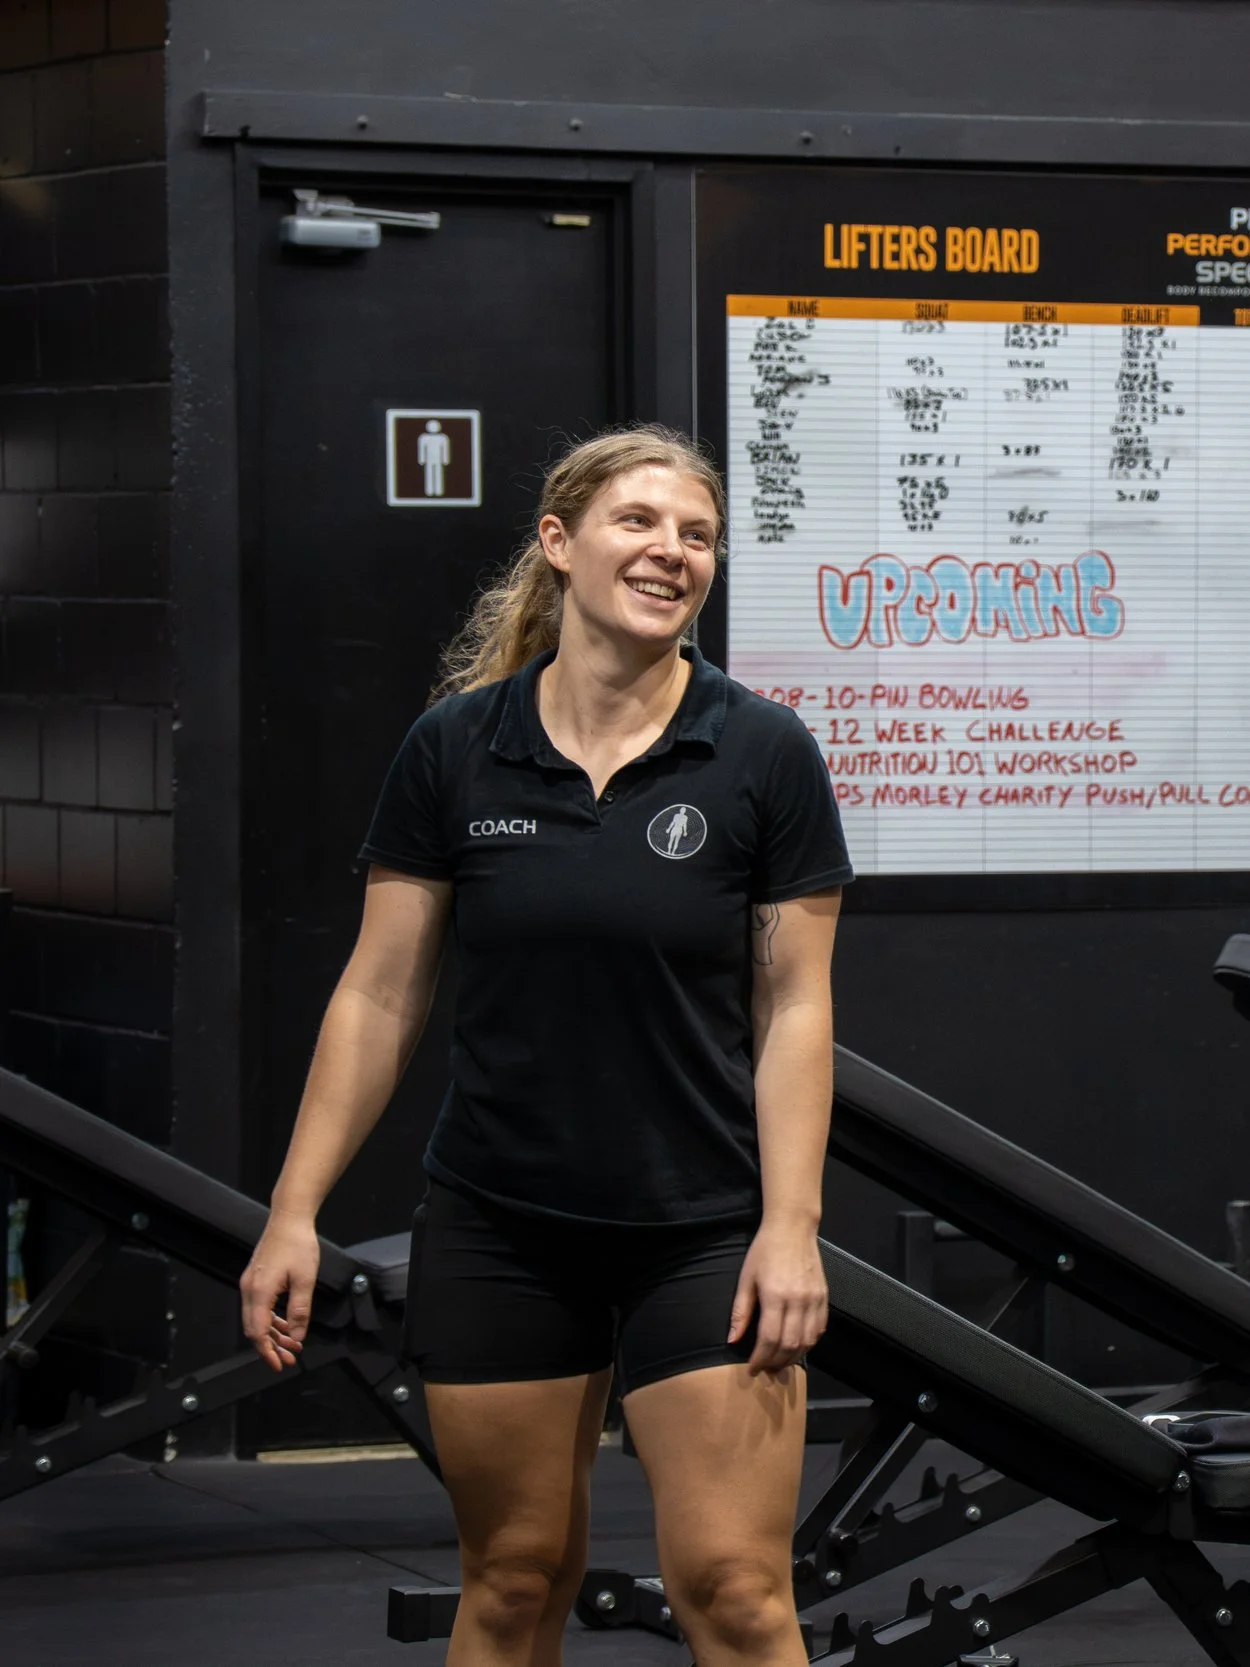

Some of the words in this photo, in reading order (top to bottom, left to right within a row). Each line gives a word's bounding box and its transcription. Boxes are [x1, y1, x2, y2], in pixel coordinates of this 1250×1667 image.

[823, 223, 938, 271] LIFTERS
[945, 226, 1041, 274] BOARD
[1166, 285, 1196, 296] BODY
[788, 301, 820, 316] NAME
[915, 303, 949, 320] SQUAT
[1023, 304, 1058, 321] BENCH
[1121, 307, 1170, 325] DEADLIFT
[918, 683, 1030, 710] BOWLING
[826, 718, 864, 745] 12
[874, 719, 947, 743] WEEK
[965, 718, 1125, 743] CHALLENGE
[996, 750, 1138, 776] WORKSHOP
[871, 782, 969, 809] MORLEY
[978, 783, 1075, 808] CHARITY
[468, 819, 537, 837] COACH
